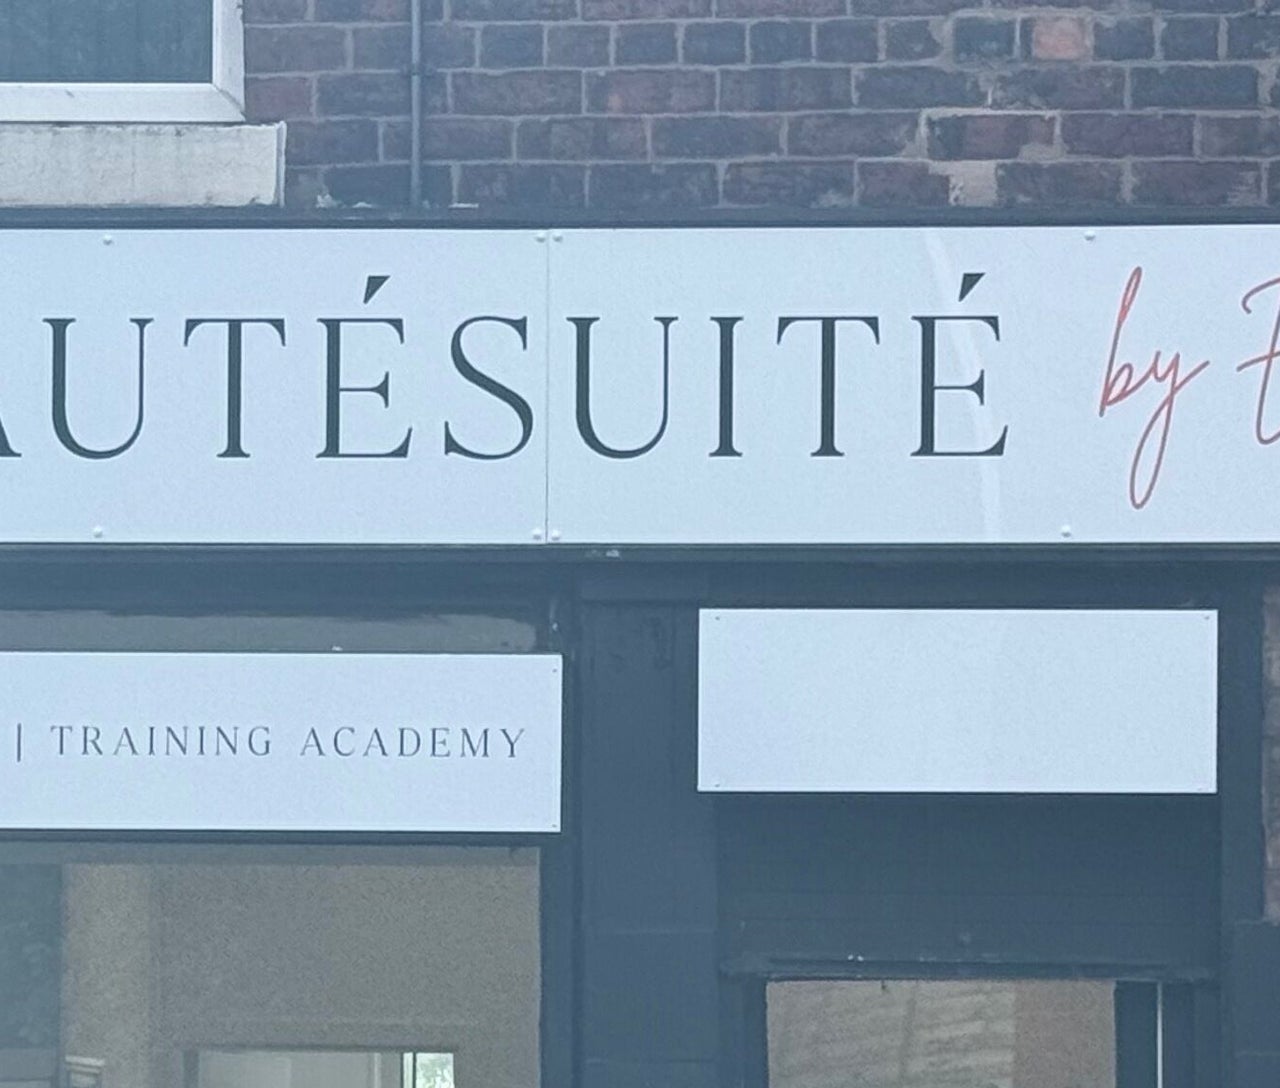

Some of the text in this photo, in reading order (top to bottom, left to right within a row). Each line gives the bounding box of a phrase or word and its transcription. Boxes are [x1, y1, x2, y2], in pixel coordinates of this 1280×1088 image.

[1098, 266, 1210, 510] by
[50, 725, 273, 757] TRAINING
[299, 726, 529, 759] ACADEMY
